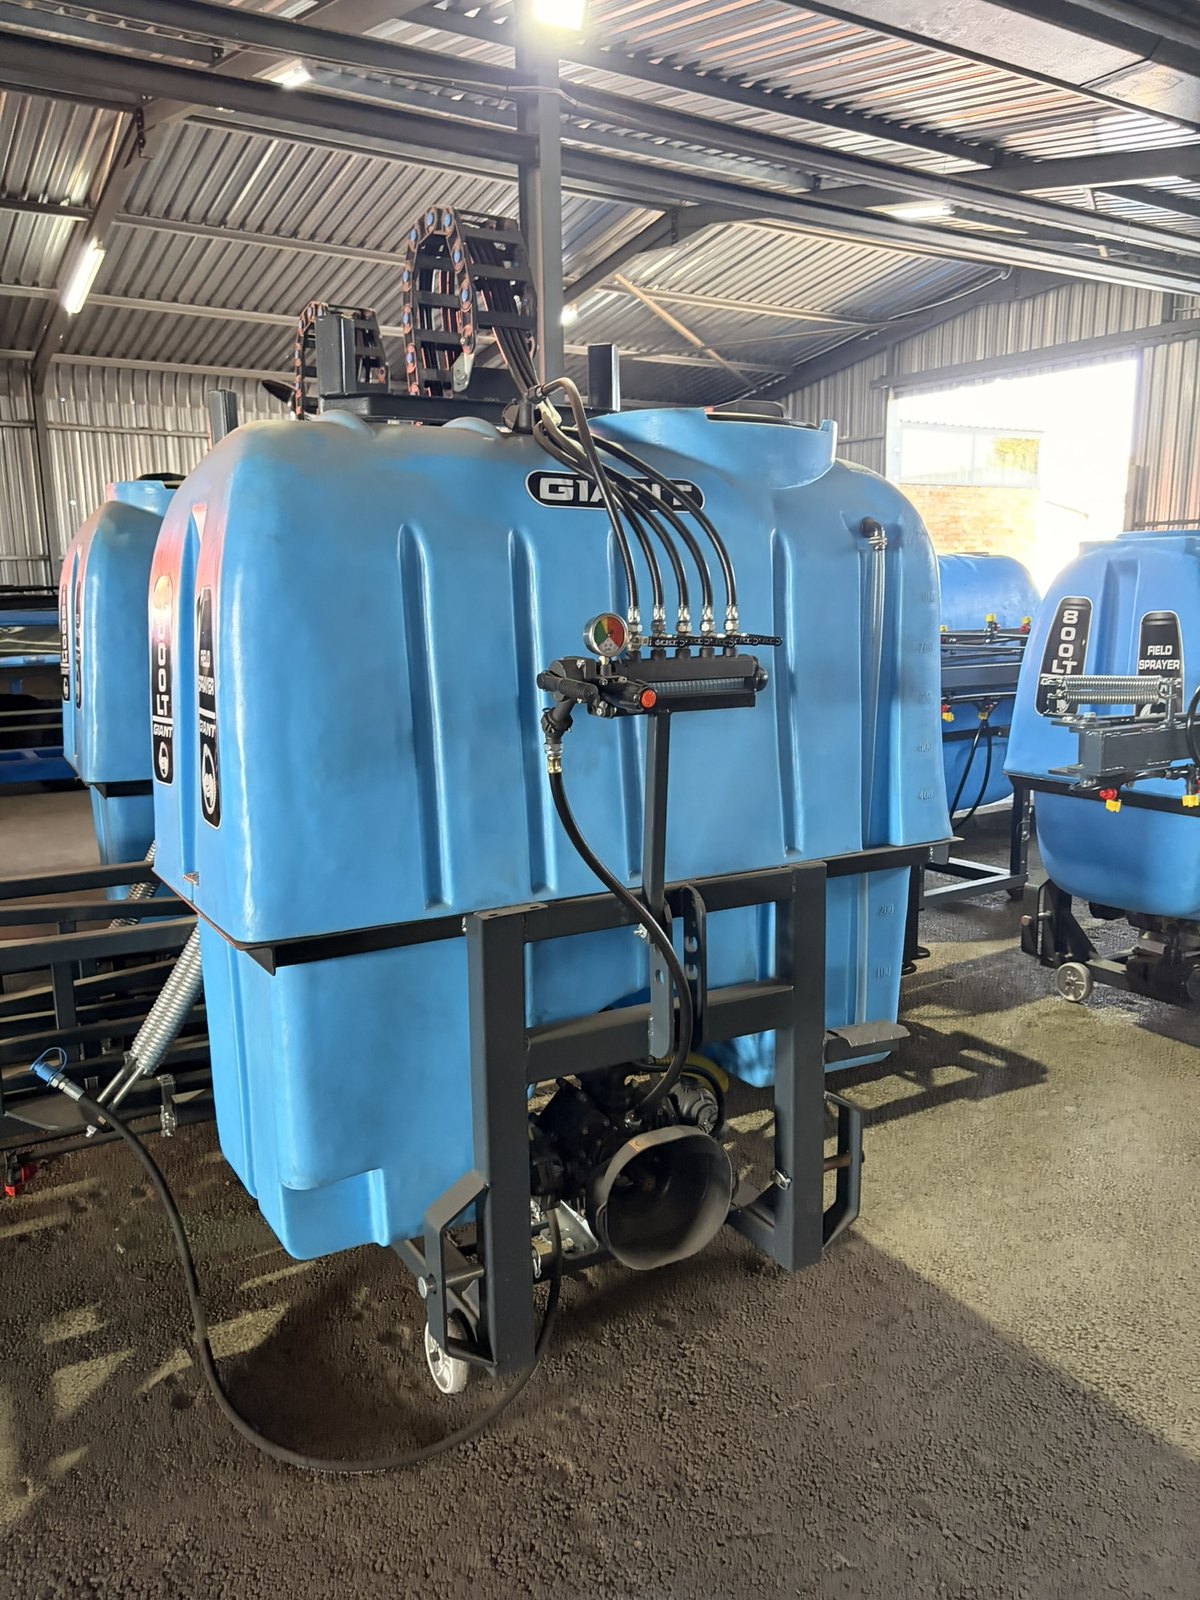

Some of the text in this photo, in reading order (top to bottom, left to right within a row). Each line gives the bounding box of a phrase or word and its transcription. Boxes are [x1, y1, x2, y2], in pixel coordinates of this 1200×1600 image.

[1058, 610, 1079, 658] 800
[1147, 645, 1173, 656] FIELD
[1051, 660, 1078, 674] LT
[1138, 659, 1180, 670] SPRAYER
[156, 694, 169, 716] LT
[153, 723, 173, 738] GIANT
